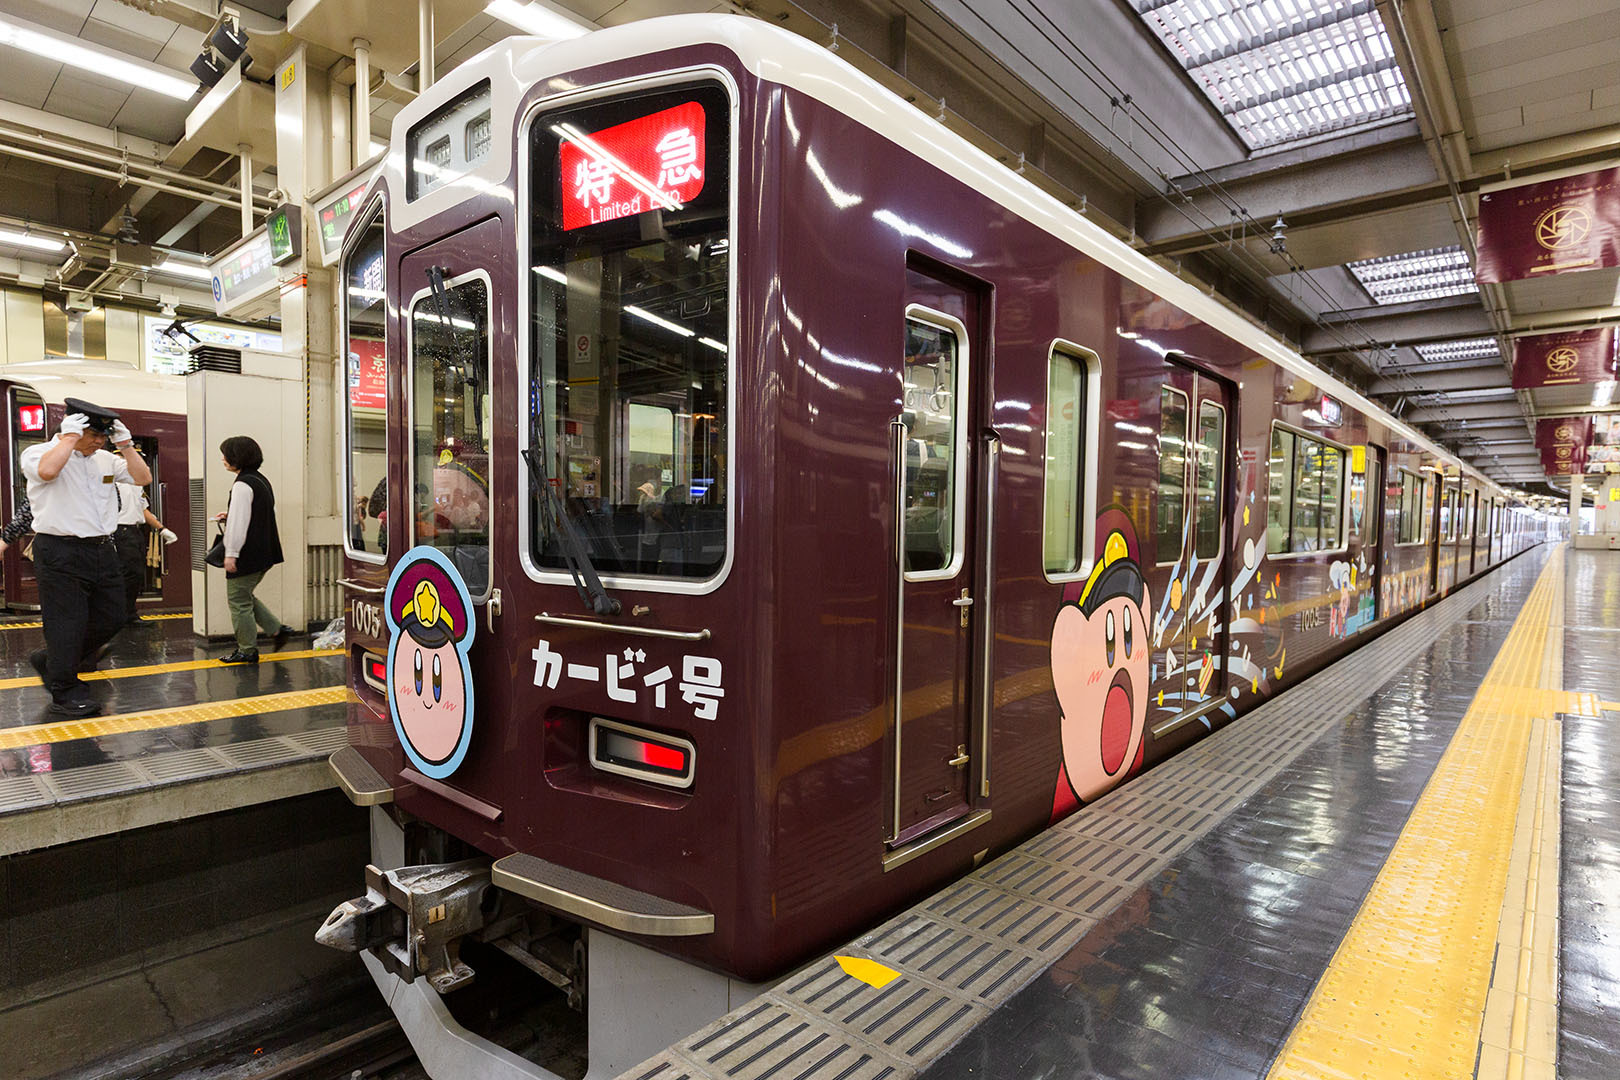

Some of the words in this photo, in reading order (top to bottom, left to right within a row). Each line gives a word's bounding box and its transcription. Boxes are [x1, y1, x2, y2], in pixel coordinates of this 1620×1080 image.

[575, 127, 702, 208] 特急
[591, 192, 641, 224] Limited
[351, 598, 381, 639] 1005
[1300, 606, 1320, 632] 1005
[530, 639, 726, 721] カービィ号
